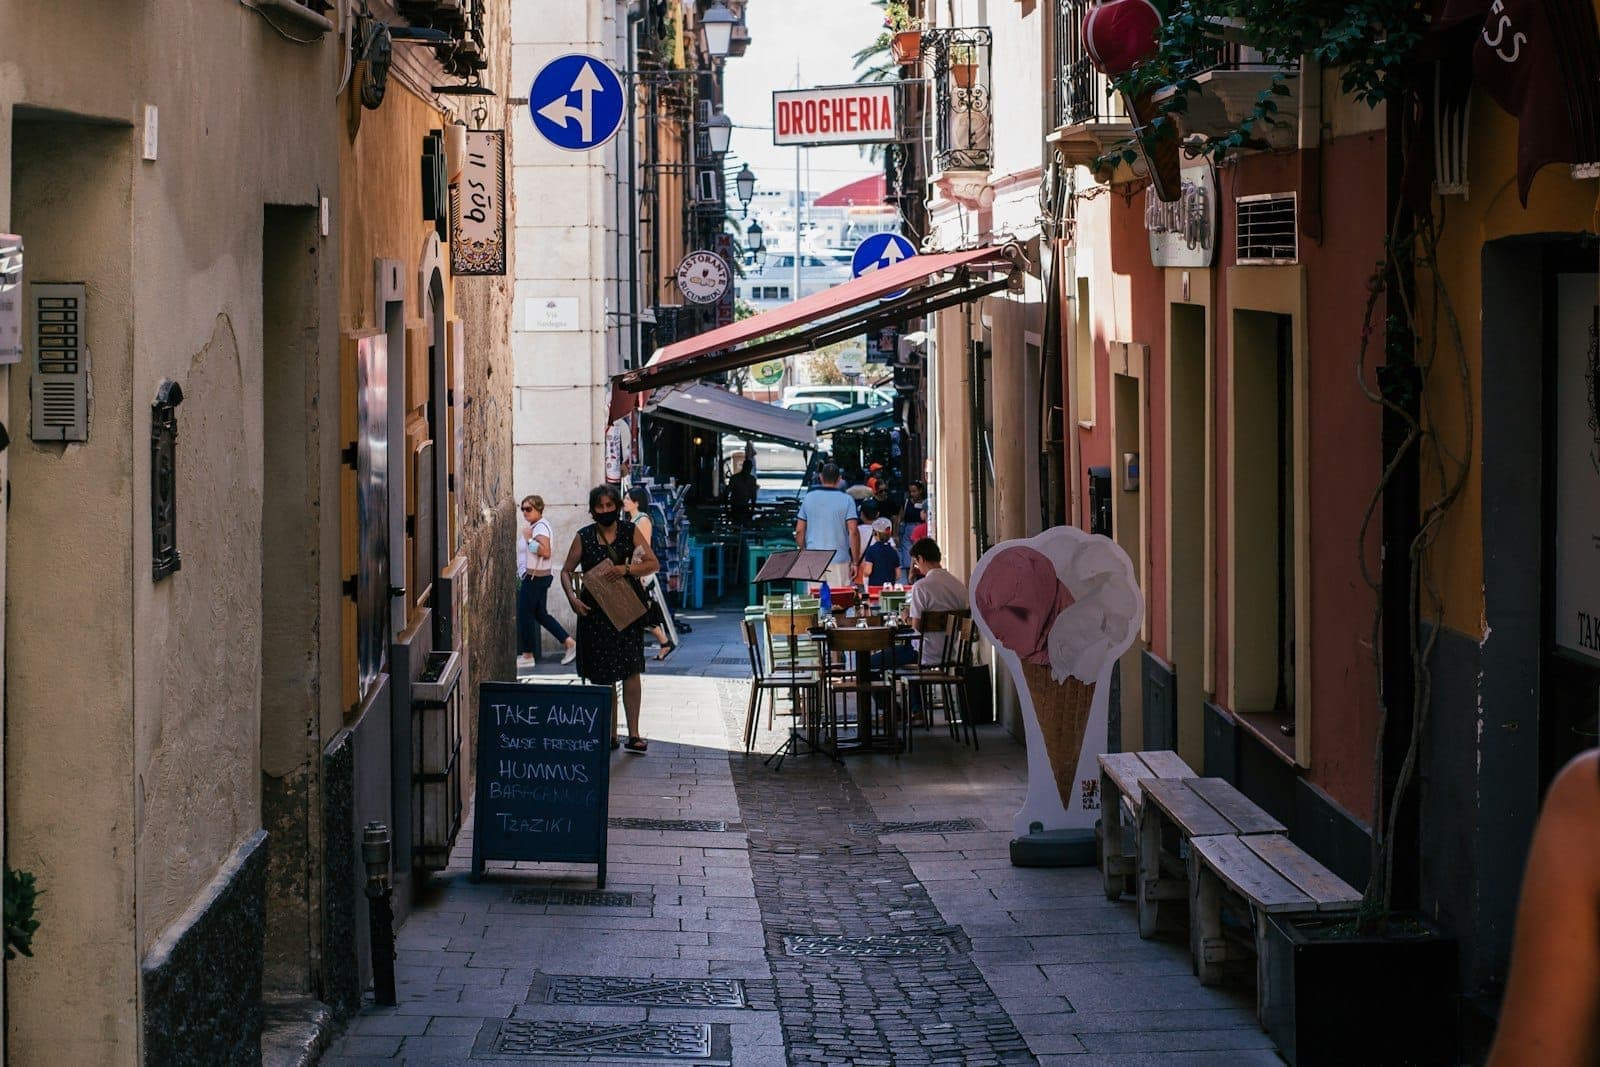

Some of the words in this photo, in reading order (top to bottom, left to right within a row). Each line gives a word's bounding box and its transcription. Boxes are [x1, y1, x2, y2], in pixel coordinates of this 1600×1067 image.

[778, 96, 892, 135] DROGHERIA
[680, 255, 726, 285] RISTORANTE
[491, 704, 539, 726] TAKE
[547, 704, 598, 733] AWAY
[499, 759, 589, 783] HUMMUS
